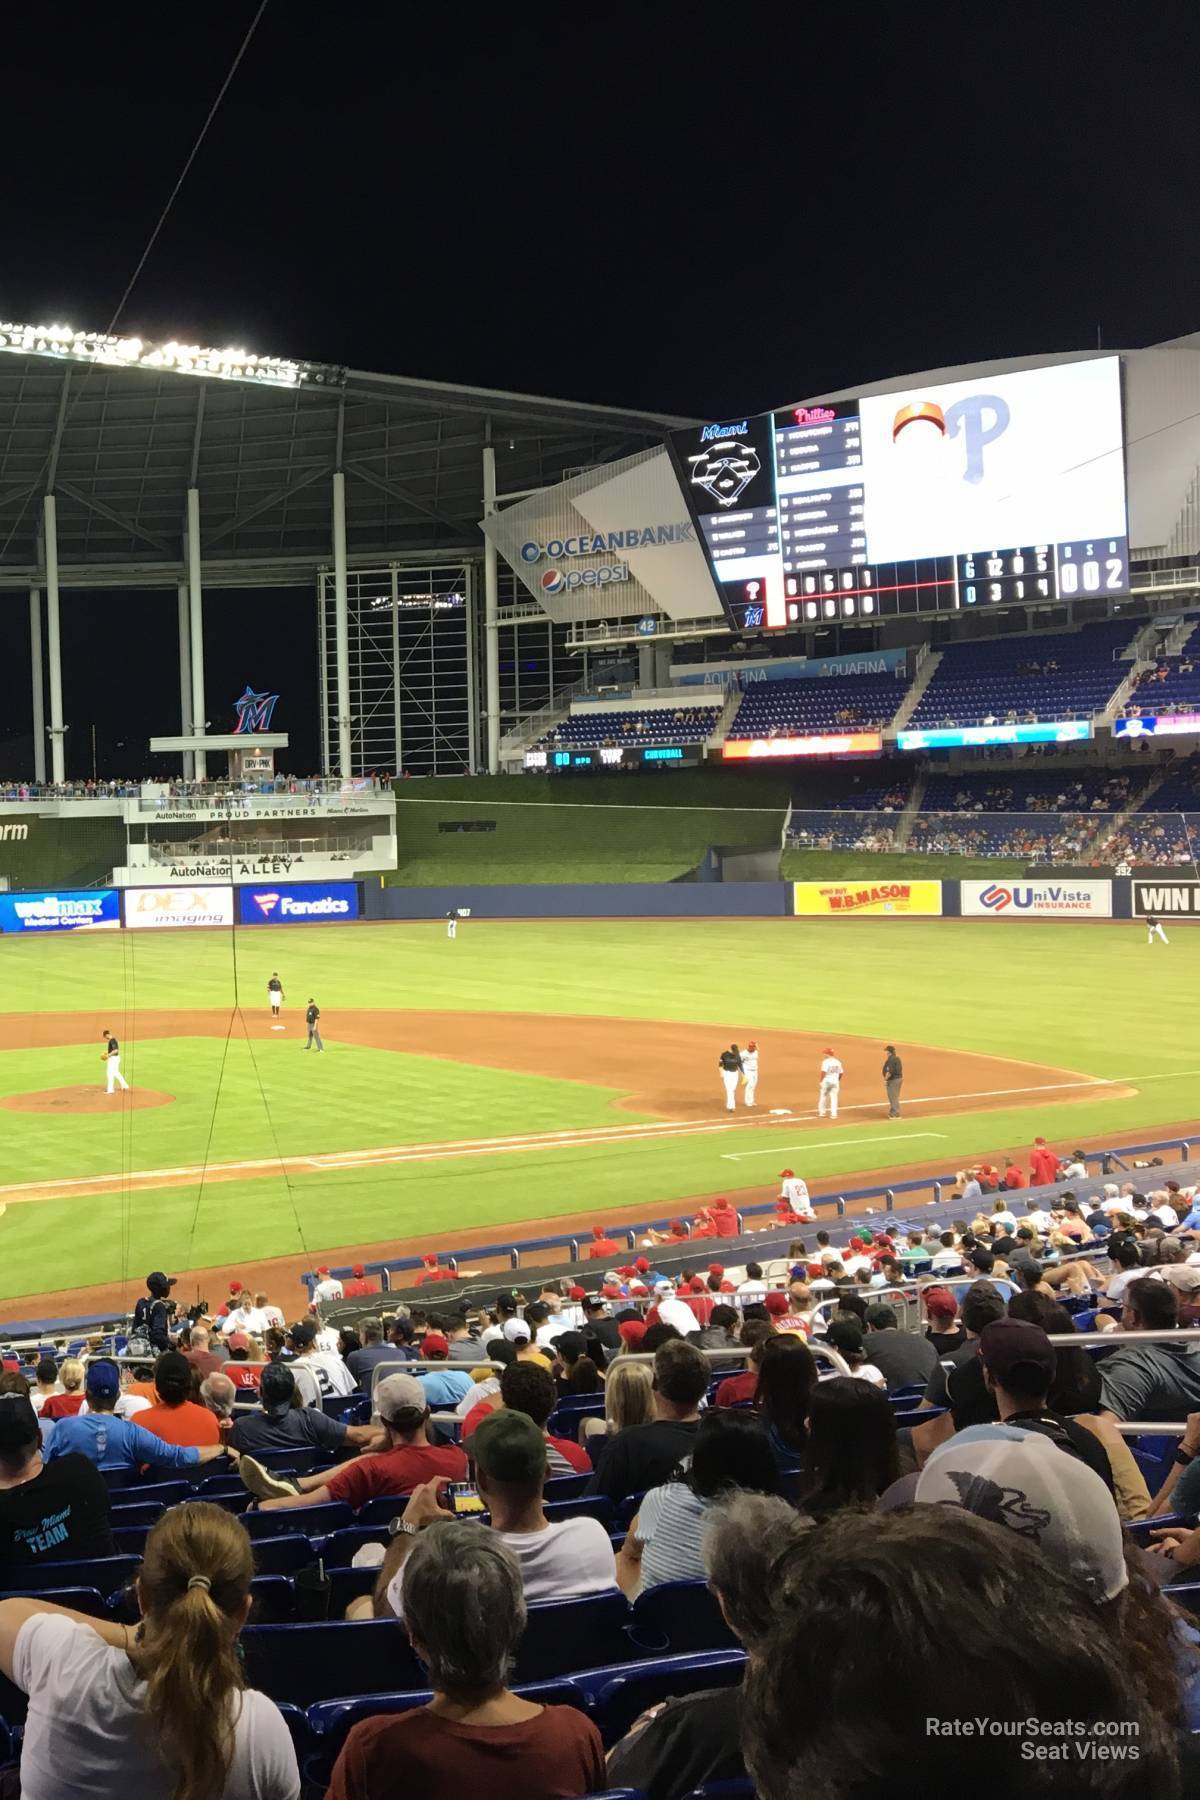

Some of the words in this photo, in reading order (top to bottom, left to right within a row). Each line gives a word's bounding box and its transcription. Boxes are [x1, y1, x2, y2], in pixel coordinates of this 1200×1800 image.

[795, 408, 836, 426] Phillies
[701, 421, 749, 442] Miami
[546, 523, 697, 559] OCEANBANK
[566, 560, 630, 592] pepsi
[824, 574, 834, 591] 5
[864, 570, 871, 587] 1
[987, 558, 1003, 576] 12
[1037, 553, 1047, 572] 5
[1061, 563, 1078, 593] 0
[1082, 561, 1100, 591] 0
[1105, 558, 1123, 588] 2
[990, 584, 1000, 602] 3
[1016, 581, 1023, 599] 1
[640, 617, 655, 632] 42
[819, 658, 887, 677] AQUAFINA
[644, 748, 683, 760] CURVEBALL
[155, 812, 196, 820] AutoNation
[170, 866, 232, 877] AutoNation
[240, 863, 292, 874] ALLEY
[1115, 867, 1132, 876] 392
[137, 892, 209, 912] DEX
[281, 898, 349, 915] Fanatics
[1013, 887, 1091, 908] UniVista
[1141, 888, 1189, 911] WIN
[14, 897, 102, 918] wellmax
[25, 918, 59, 927] Medical
[62, 916, 93, 925] Centers
[155, 914, 223, 923] imaging
[241, 1373, 255, 1385] LEE
[26, 1522, 69, 1554] TEAM
